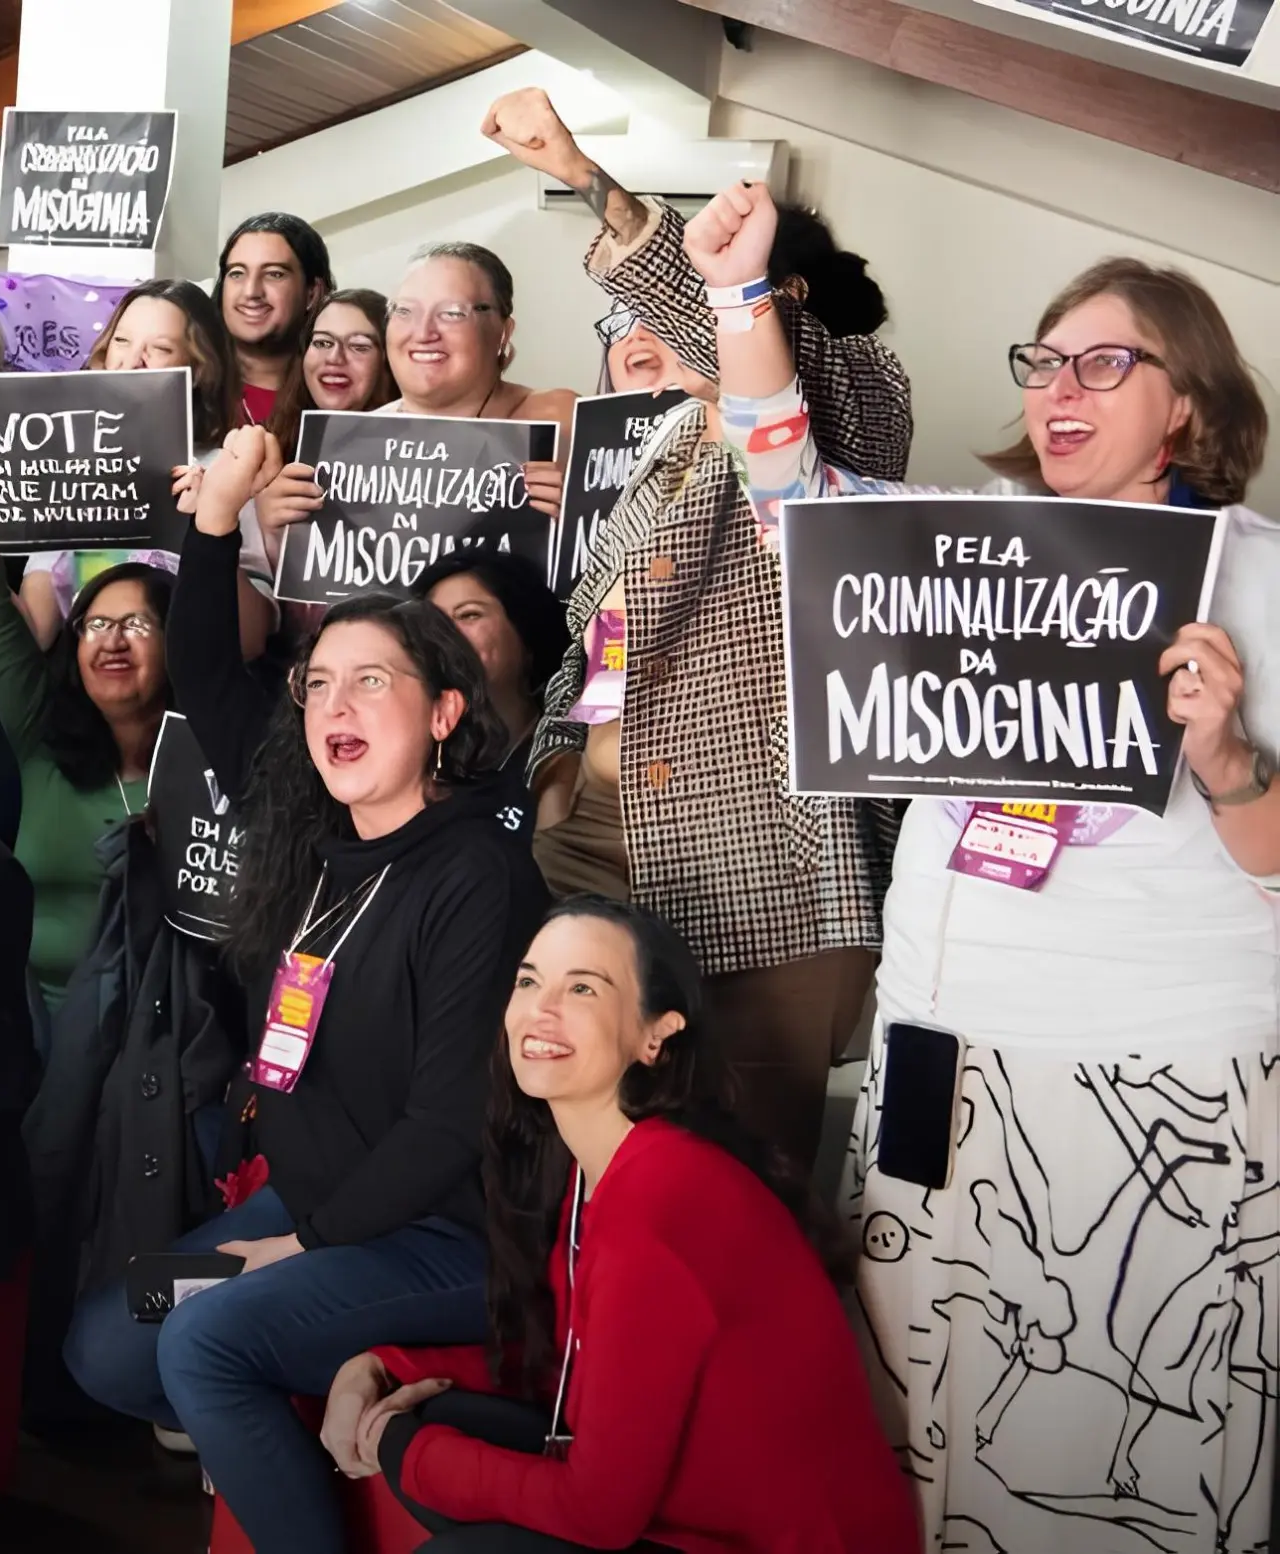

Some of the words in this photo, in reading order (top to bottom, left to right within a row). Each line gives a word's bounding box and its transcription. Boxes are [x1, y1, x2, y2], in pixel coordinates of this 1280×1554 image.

[11, 185, 150, 236] MISOGINIA
[935, 534, 1031, 567] PELA
[832, 567, 1159, 648] CRIMINALIZAÇÃO
[960, 648, 997, 676] DA
[825, 662, 1161, 776] MISOGINIA
